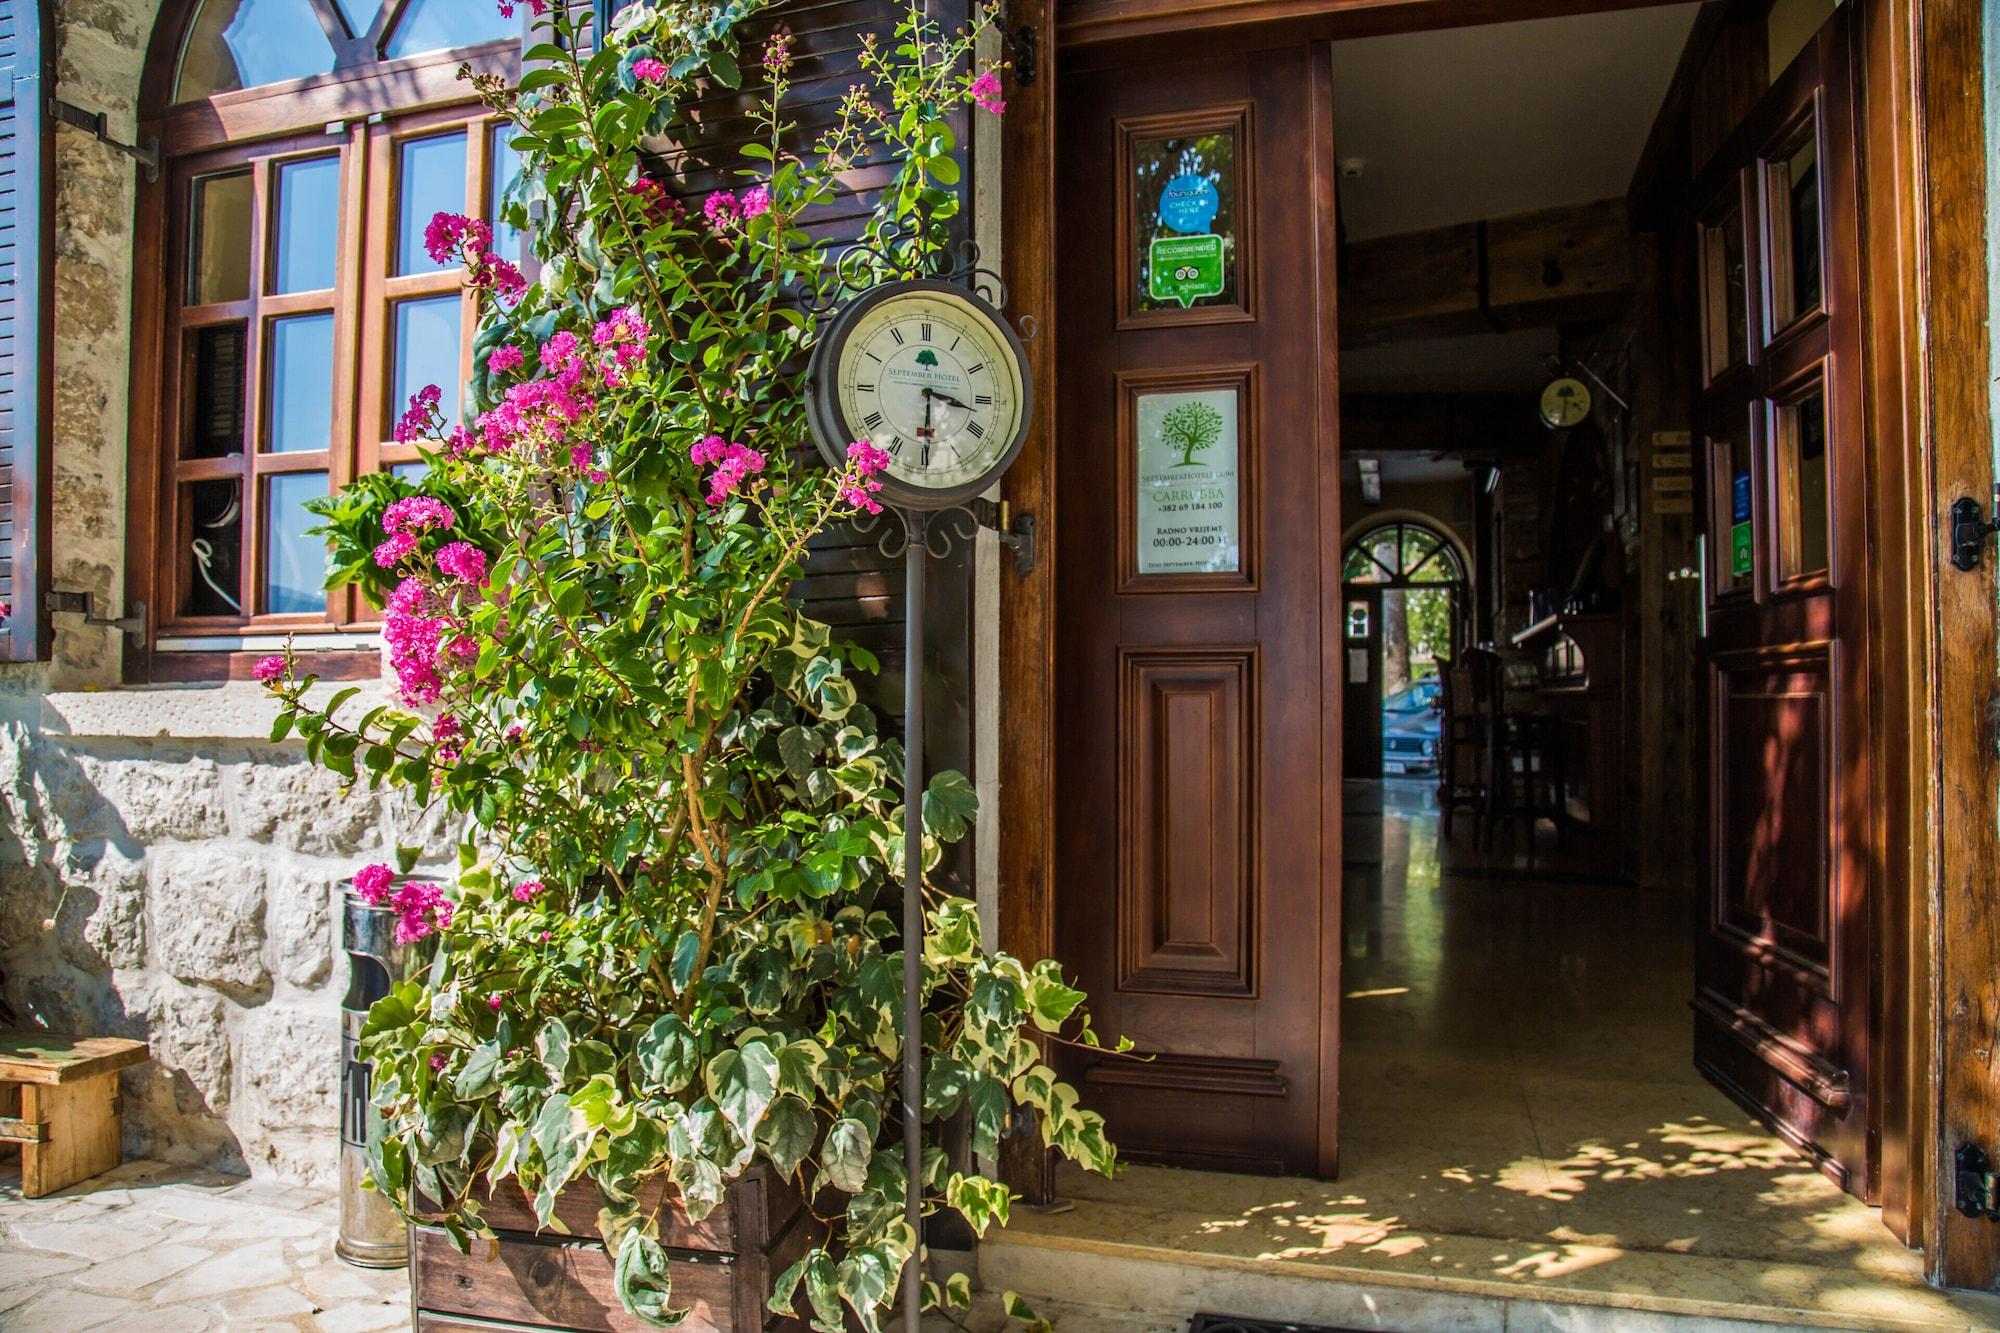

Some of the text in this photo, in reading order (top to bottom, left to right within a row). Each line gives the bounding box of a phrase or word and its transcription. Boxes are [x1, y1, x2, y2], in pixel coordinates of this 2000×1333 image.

[1169, 200, 1197, 208] CHECK
[1156, 243, 1217, 254] RECOMMENDED
[888, 369, 961, 382] SEPTEMBER HOTEL
[1142, 471, 1234, 482] SEPTEMBERHOTELSCOM
[1158, 502, 1223, 513] +382 69 184 100
[1157, 524, 1223, 535] RADNO VRIJEME
[1153, 535, 1214, 548] 00:00-24:00
